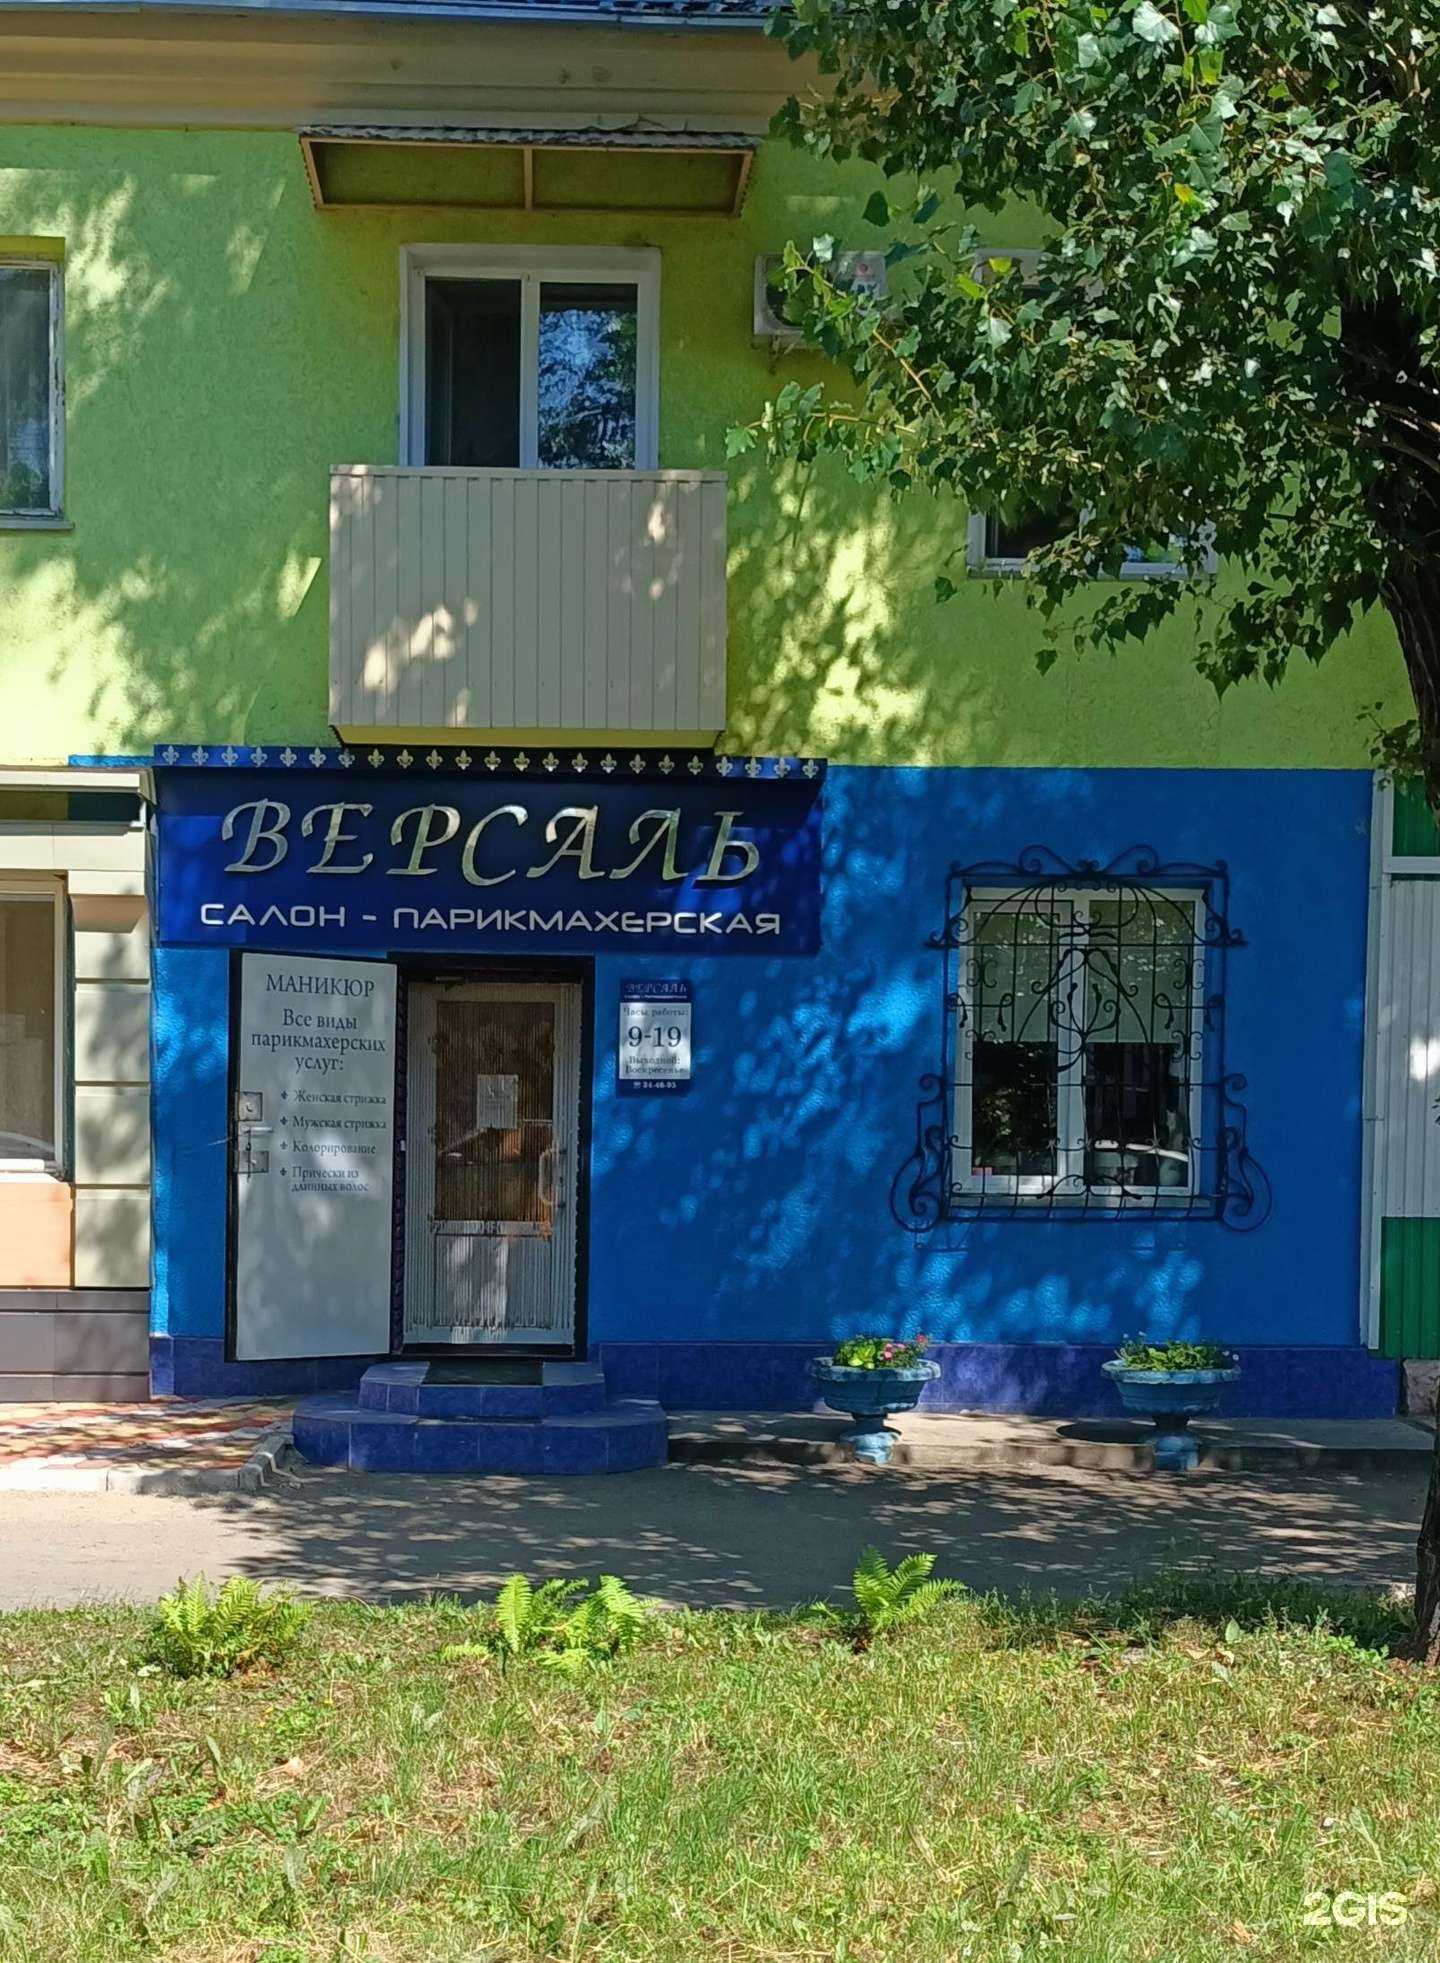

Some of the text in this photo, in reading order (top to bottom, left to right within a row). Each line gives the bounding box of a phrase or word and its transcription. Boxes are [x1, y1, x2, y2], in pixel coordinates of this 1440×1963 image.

[220, 797, 761, 886] ВЕРСАЛЬ
[200, 903, 346, 927] САЛОН
[392, 907, 781, 936] ПАРИКМАХЕРСКАЯ
[266, 973, 376, 998] МАНИКЮР
[282, 1008, 358, 1030] Все виды
[251, 1033, 387, 1055] парикмахерских
[628, 1026, 682, 1048] 9-19
[295, 1056, 344, 1076] услуг:
[294, 1089, 341, 1104] Женская
[292, 1116, 342, 1130] Мужская
